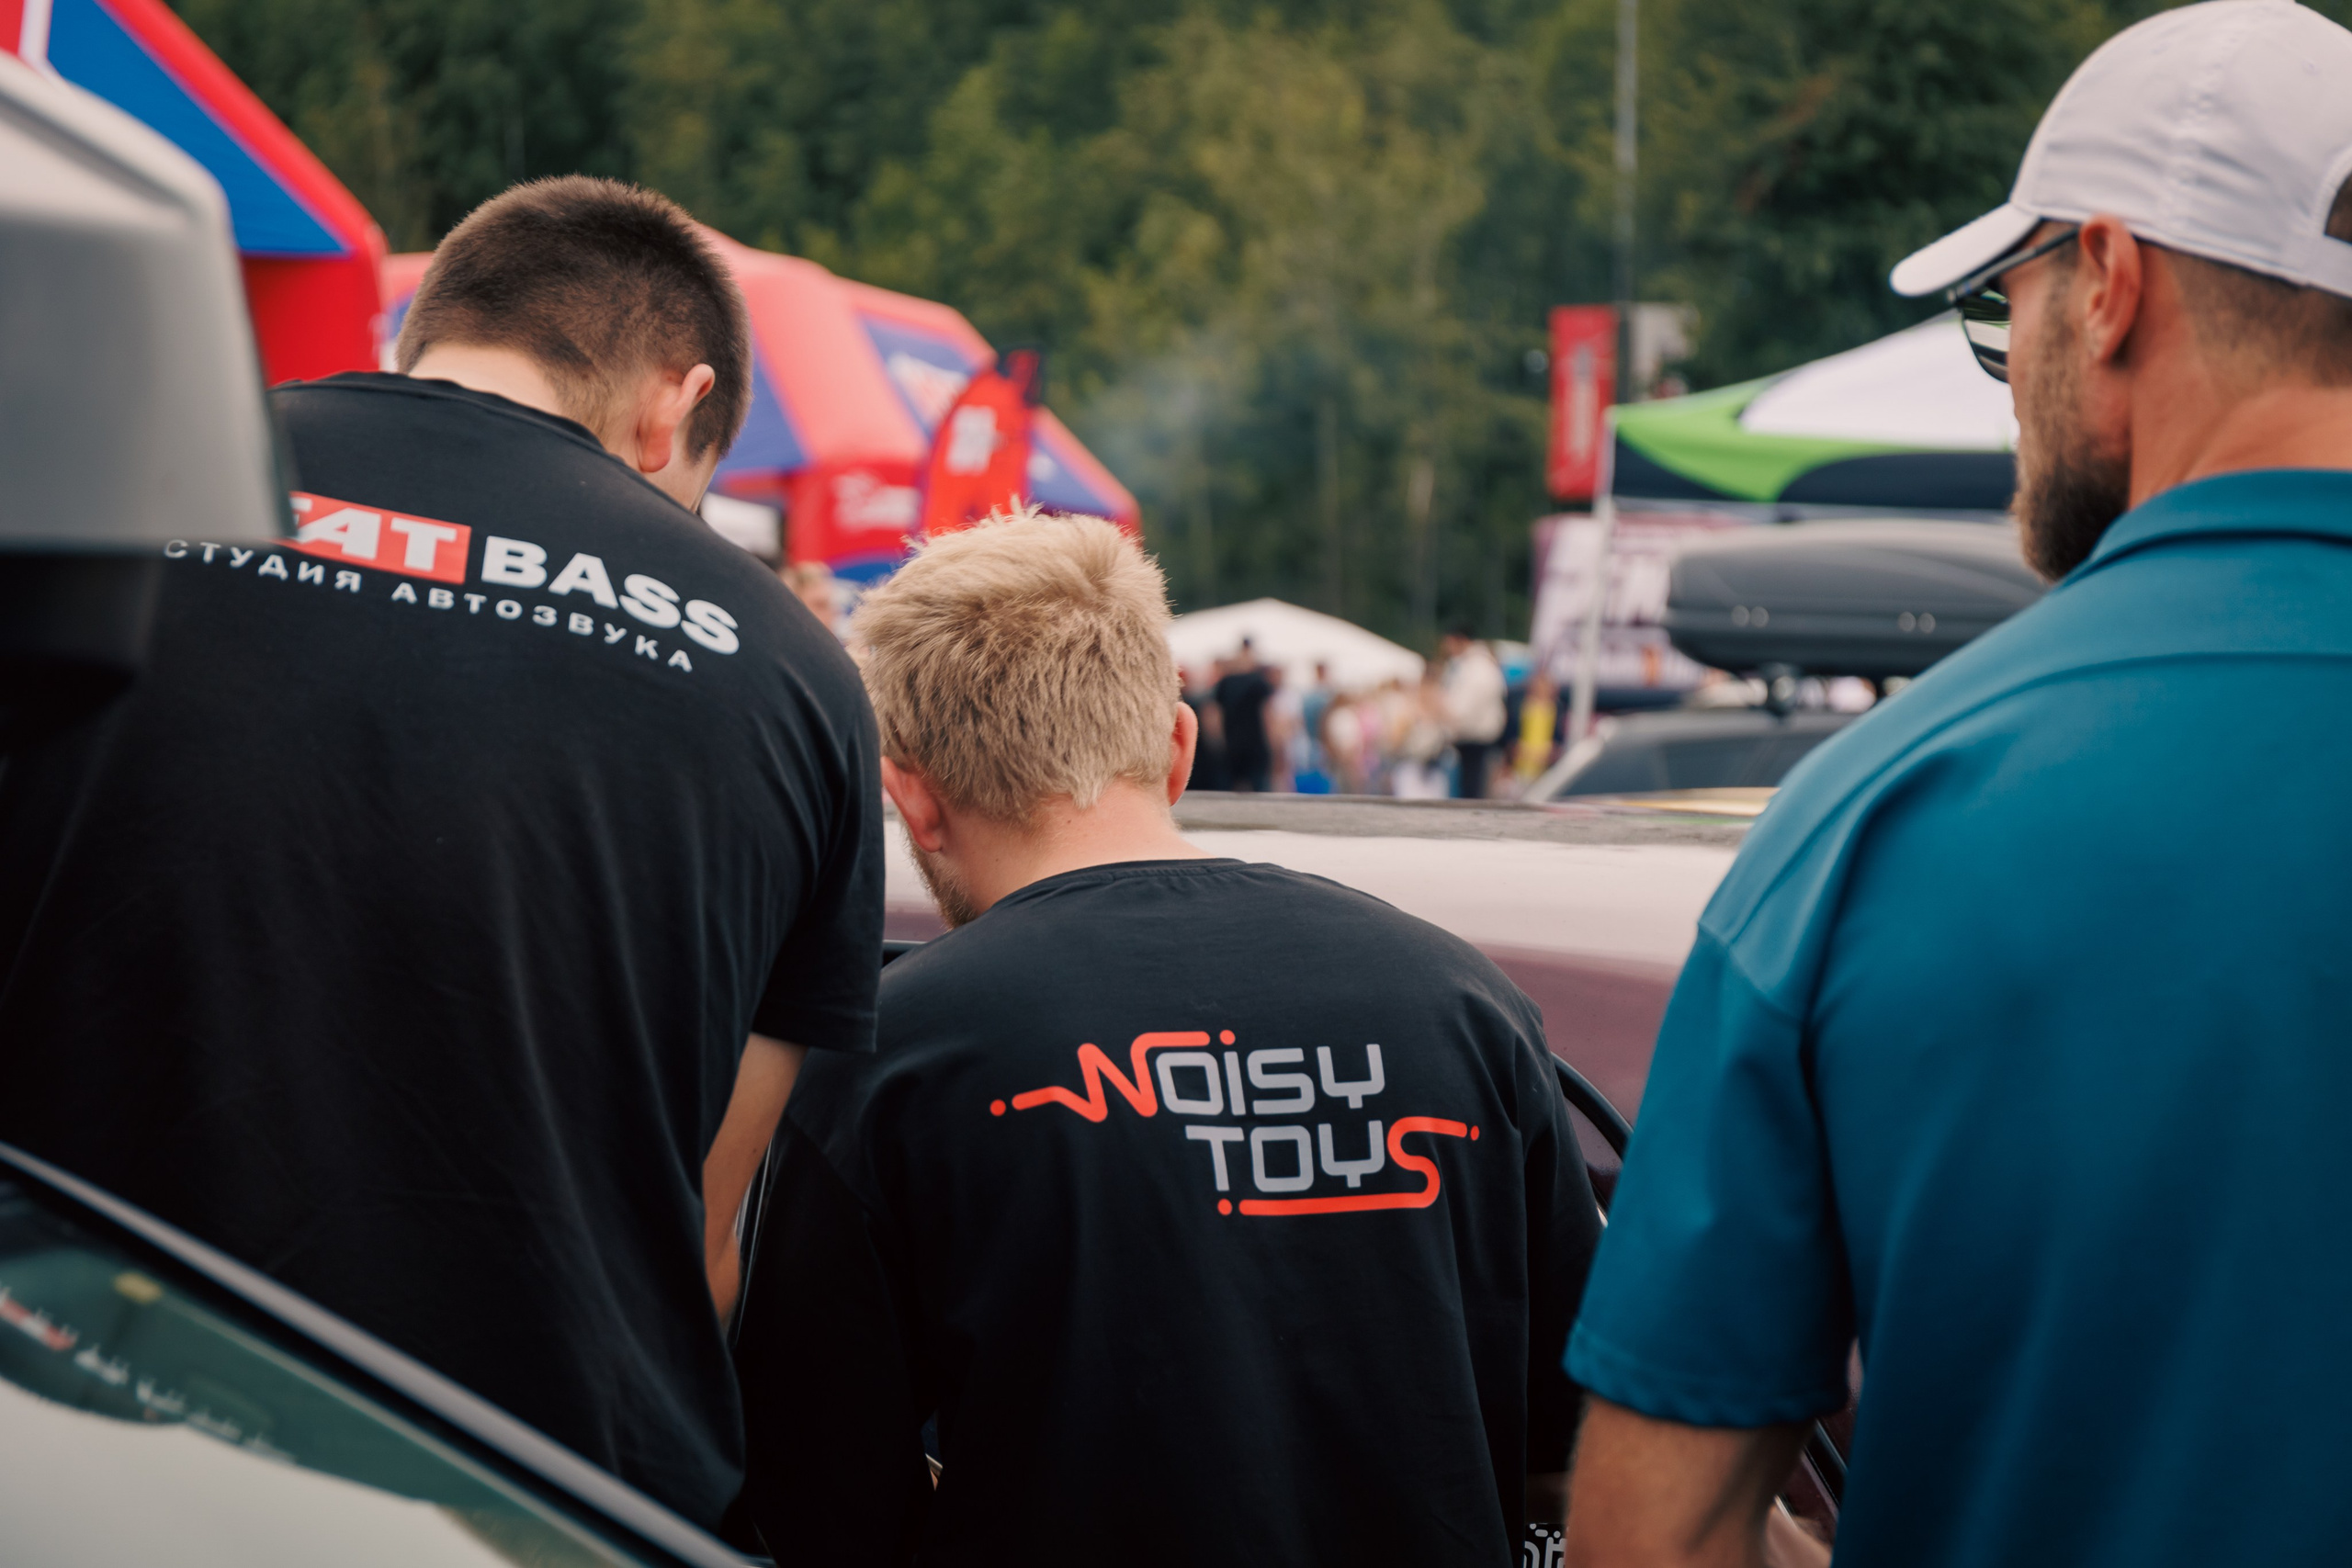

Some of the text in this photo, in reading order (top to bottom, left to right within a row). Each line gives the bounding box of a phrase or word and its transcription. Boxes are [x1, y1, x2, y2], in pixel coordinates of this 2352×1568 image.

[164, 539, 693, 671] СТУДИЯ АВТОЗВУКА
[481, 536, 739, 654] BASS
[1184, 1116, 1479, 1216] TOYS
